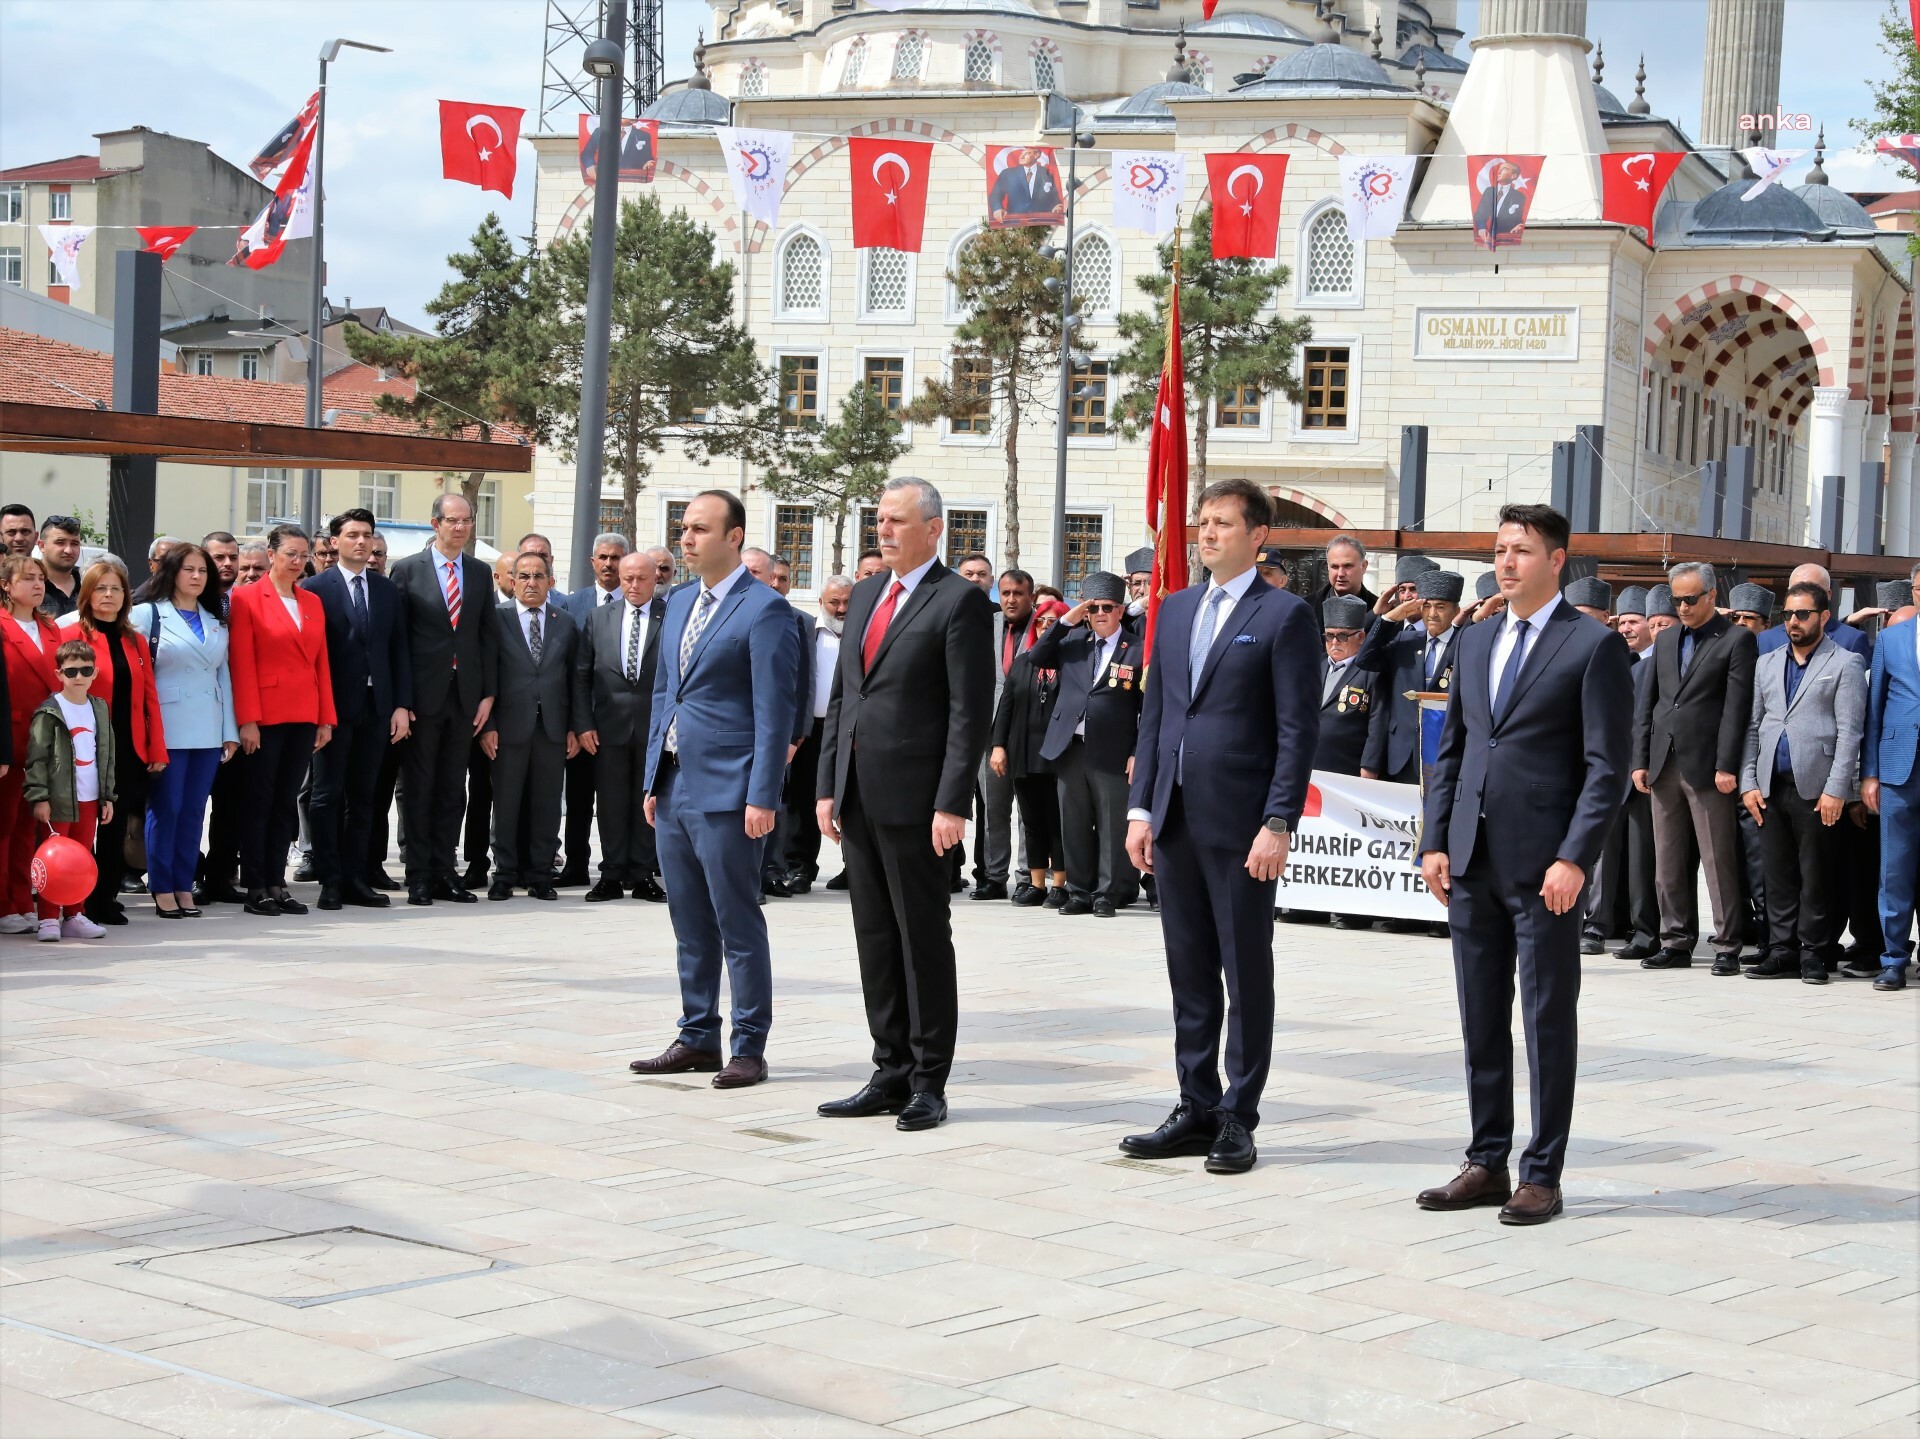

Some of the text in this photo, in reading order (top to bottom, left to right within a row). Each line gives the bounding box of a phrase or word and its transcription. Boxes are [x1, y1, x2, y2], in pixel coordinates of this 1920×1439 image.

[1427, 313, 1567, 337] OSMANLI CAMİİ
[1526, 339, 1547, 349] 1420
[1354, 808, 1420, 838] TÜRKİ
[1289, 832, 1362, 857] UHARİP
[1281, 863, 1430, 894] ÇERKEZKÖY TE
